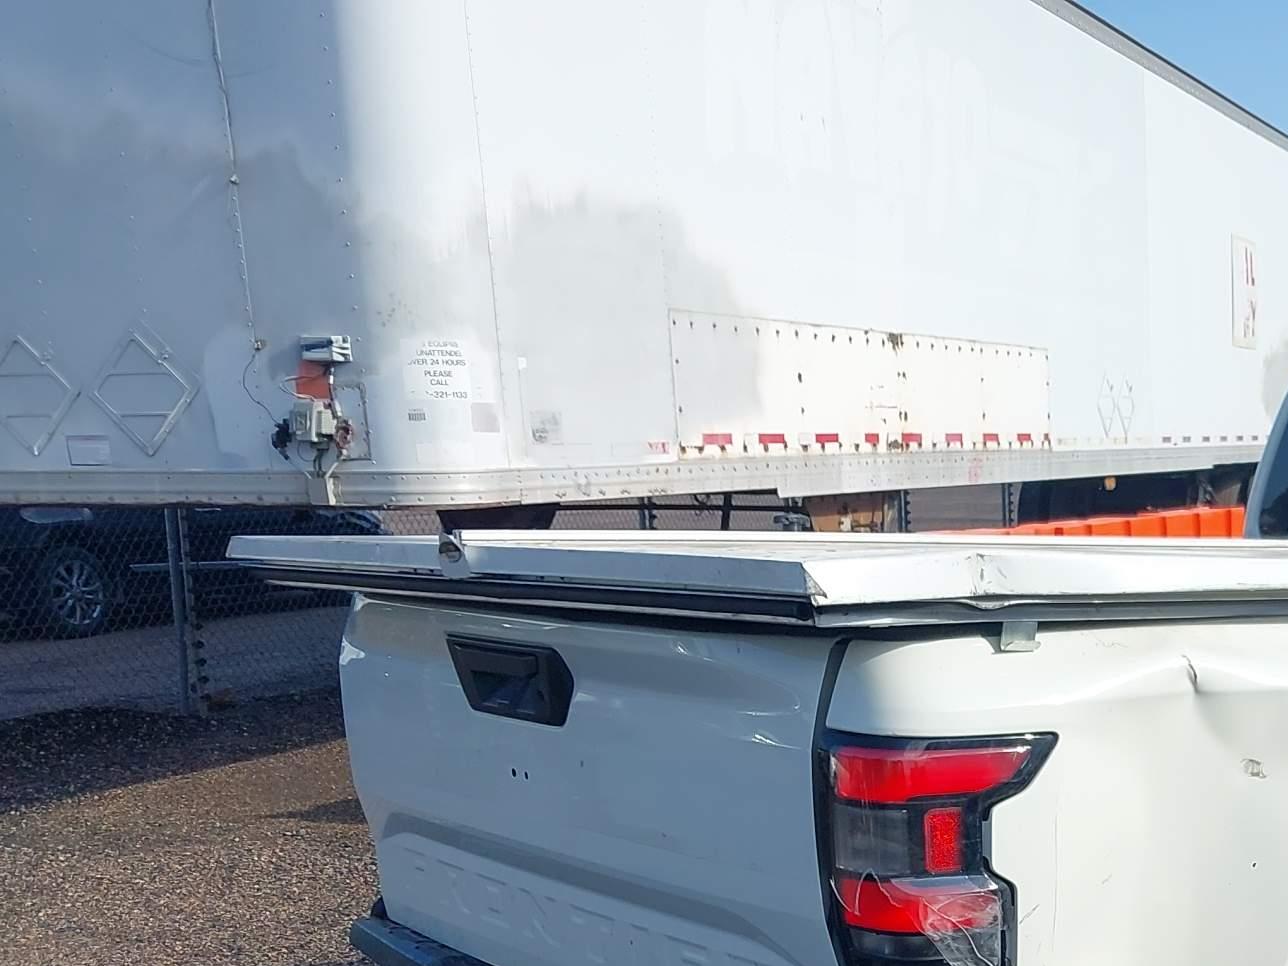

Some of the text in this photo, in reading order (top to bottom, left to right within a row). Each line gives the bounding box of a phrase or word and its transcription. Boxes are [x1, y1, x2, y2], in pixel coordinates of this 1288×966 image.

[430, 358, 440, 366] 24
[442, 358, 466, 367] HOURS
[423, 370, 453, 378] PLEASE
[430, 378, 449, 386] CALL
